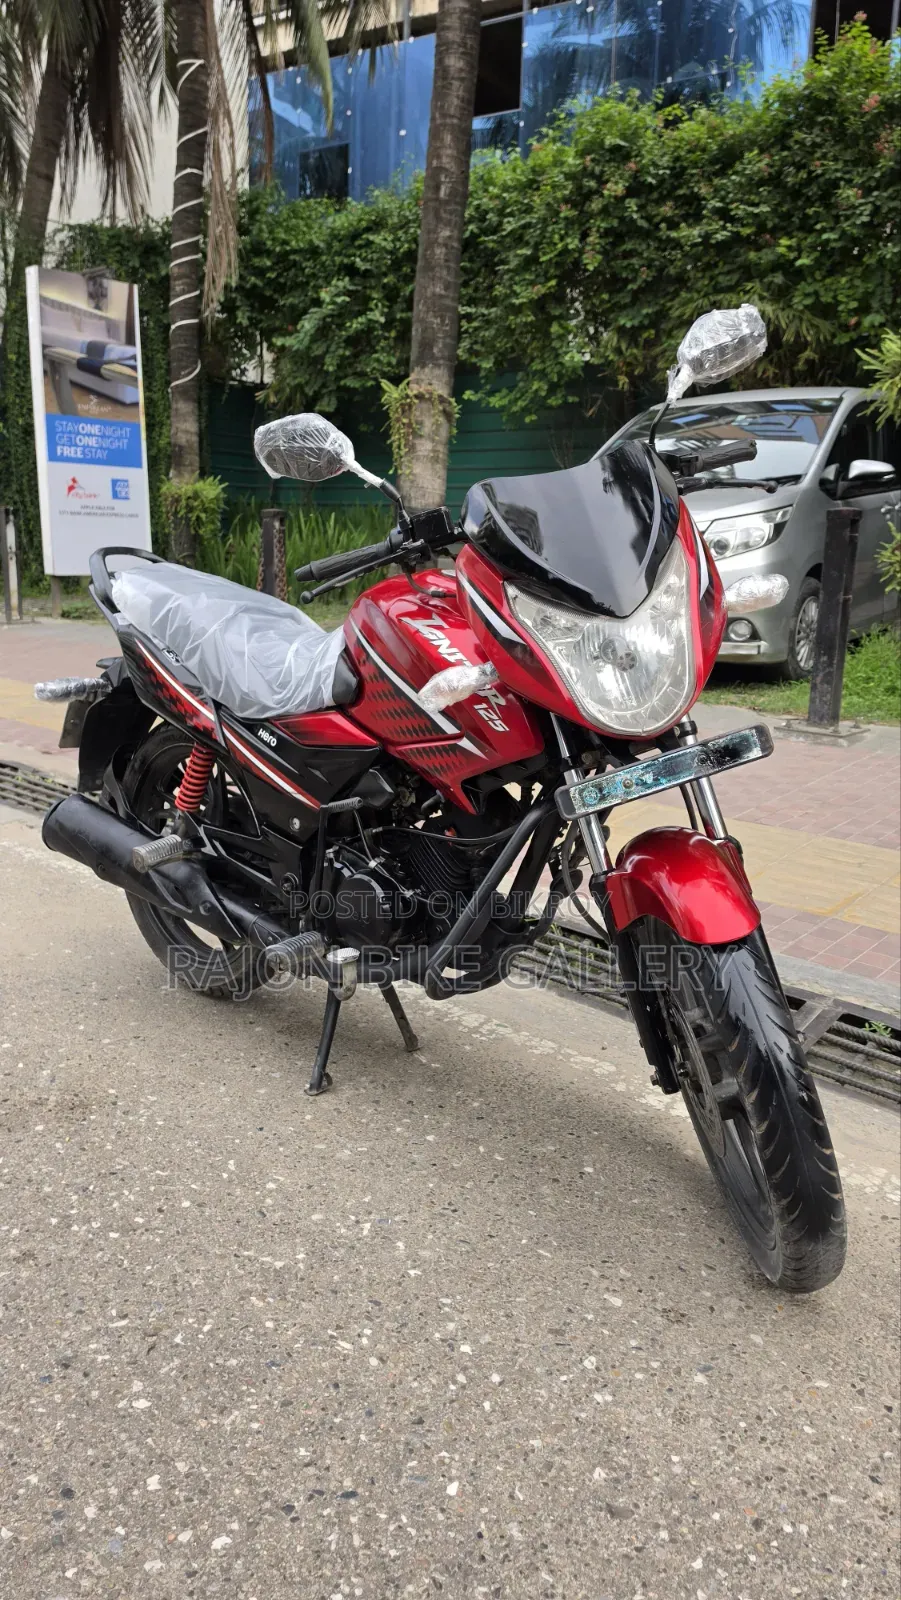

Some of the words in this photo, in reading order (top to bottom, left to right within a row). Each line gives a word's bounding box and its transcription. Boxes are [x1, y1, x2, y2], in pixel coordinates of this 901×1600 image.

[56, 445, 83, 458] FREE
[84, 447, 108, 460] STAY
[473, 702, 509, 732] 125
[258, 728, 277, 747] Hero
